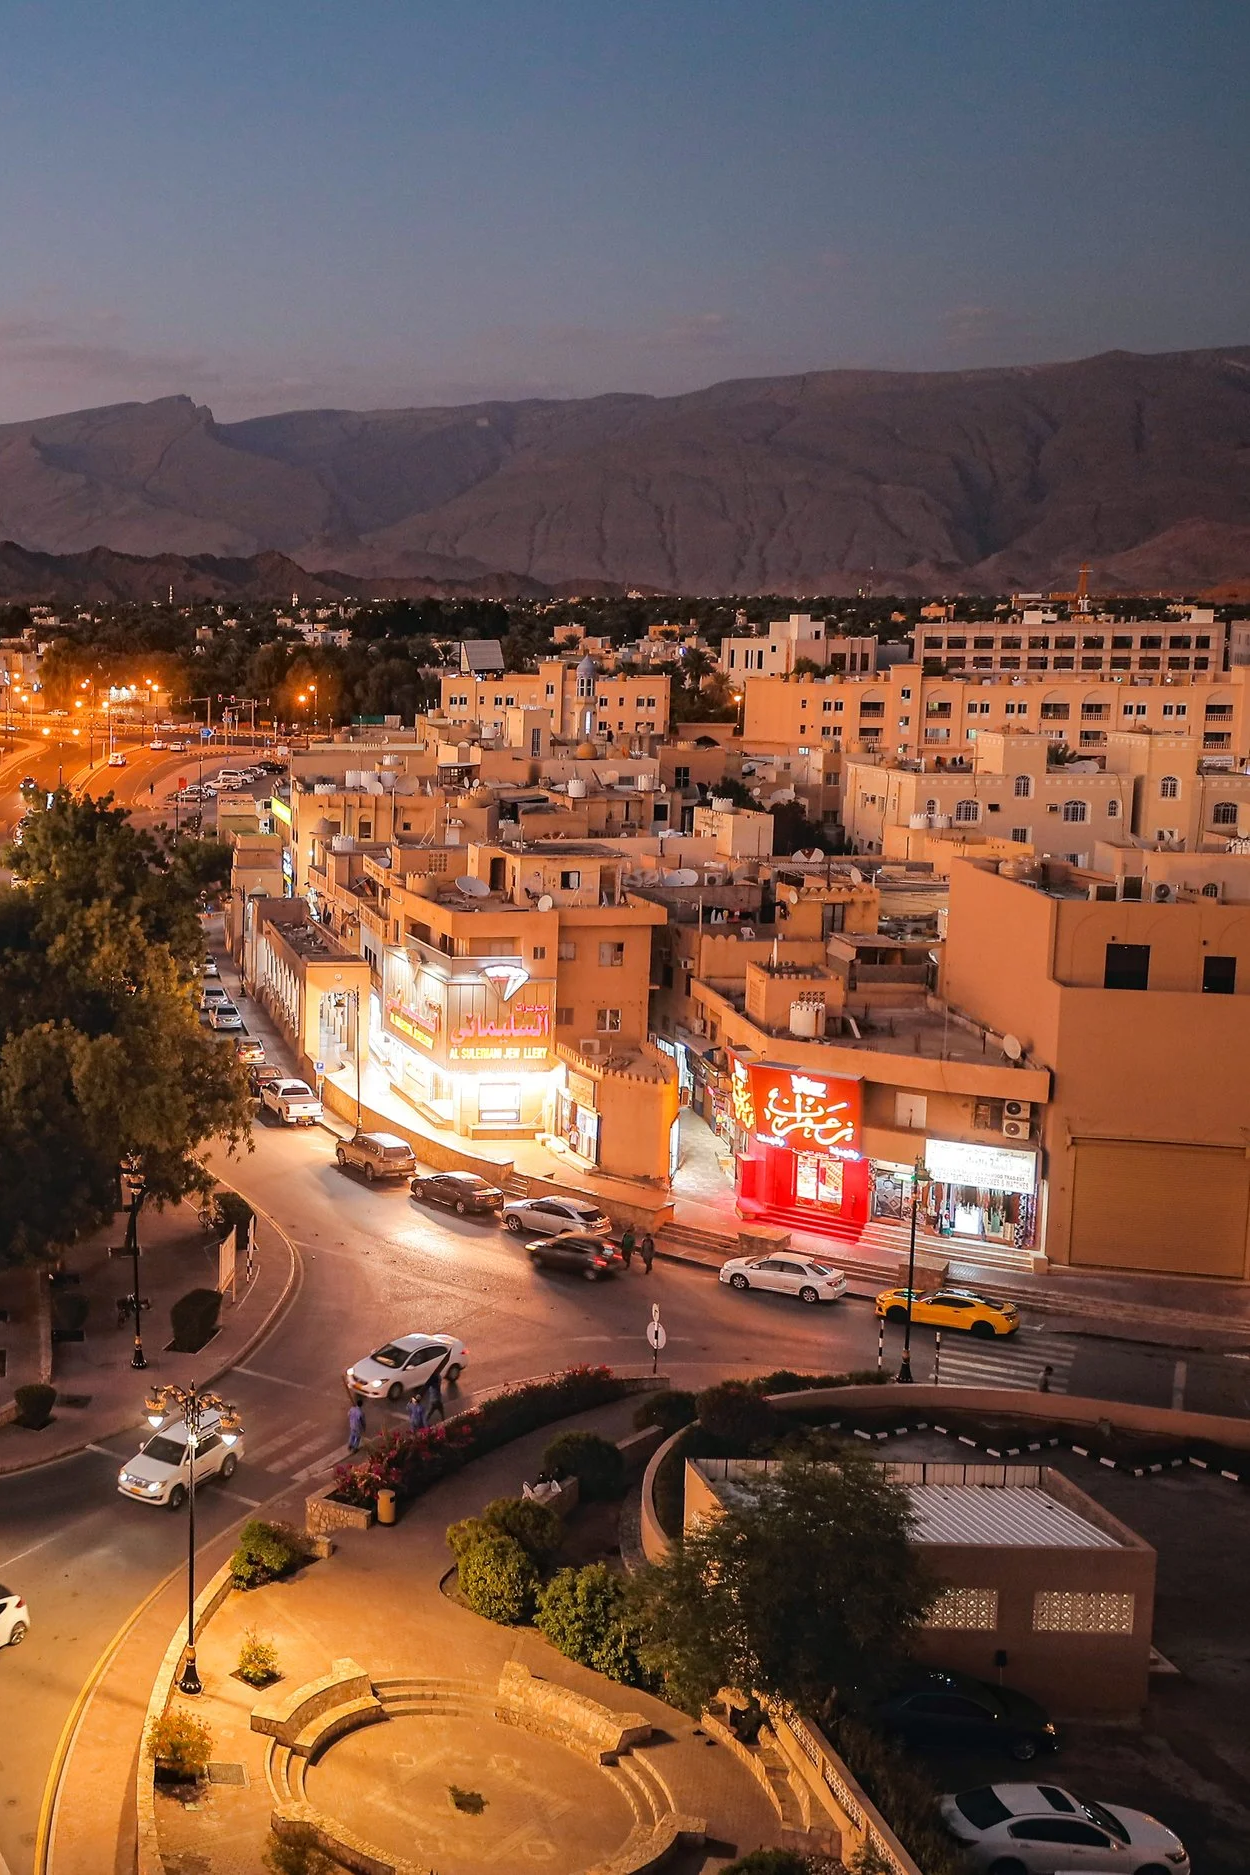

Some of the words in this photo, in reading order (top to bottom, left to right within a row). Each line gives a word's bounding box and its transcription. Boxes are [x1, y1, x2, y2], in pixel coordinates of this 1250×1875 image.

[515, 1002, 549, 1014] مجوهرات
[451, 1013, 549, 1048] السليماني
[450, 1047, 460, 1060] AL
